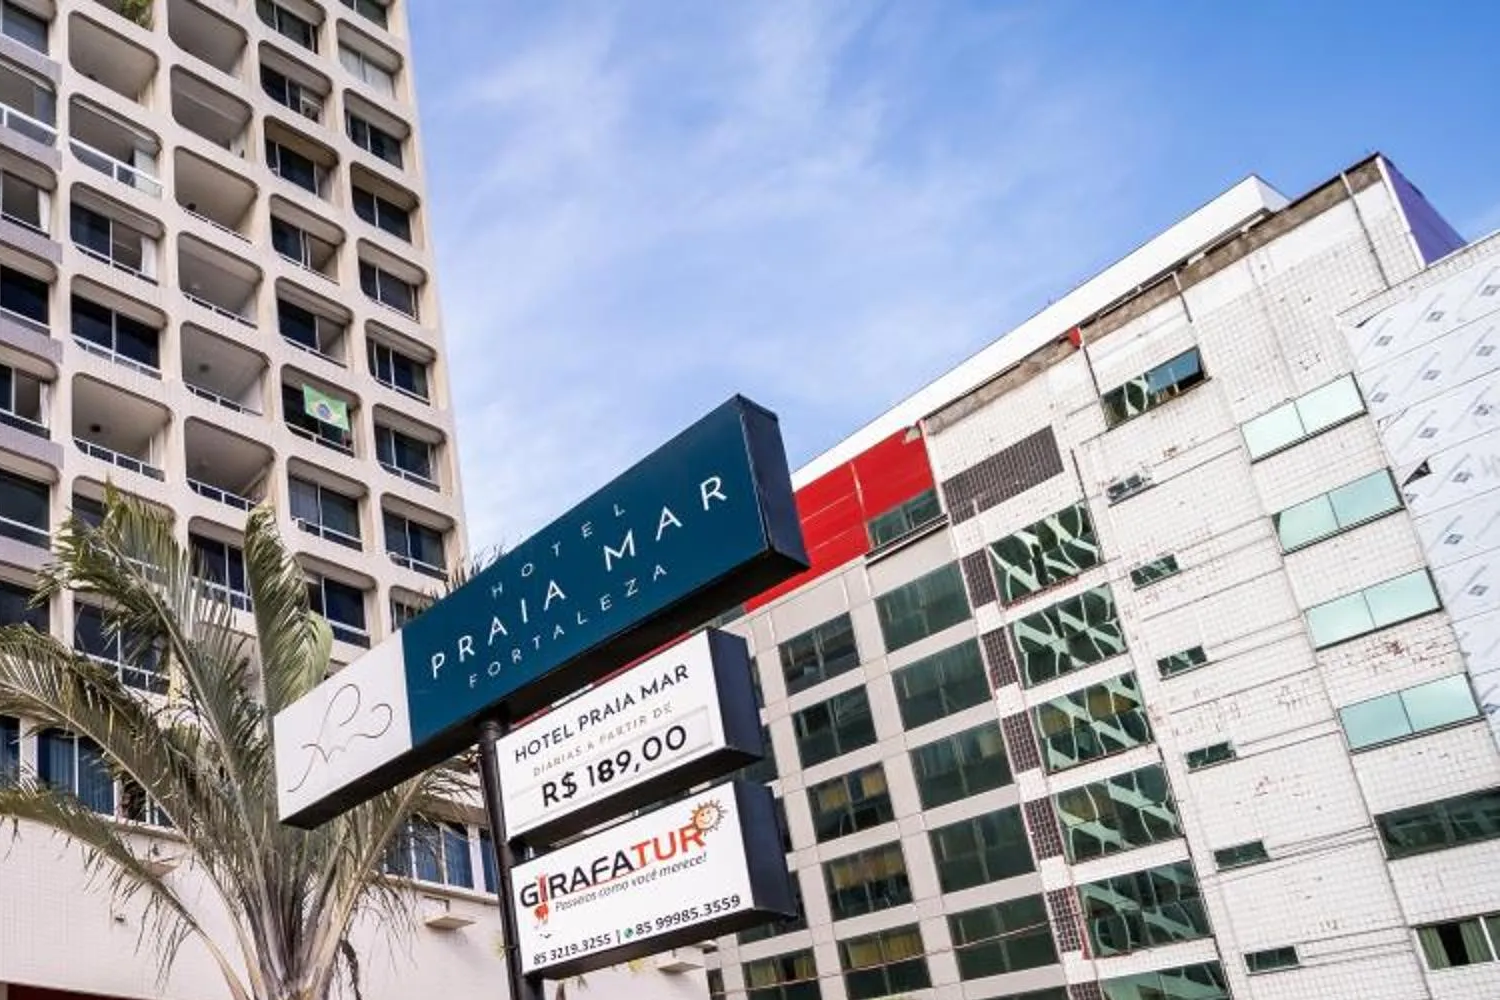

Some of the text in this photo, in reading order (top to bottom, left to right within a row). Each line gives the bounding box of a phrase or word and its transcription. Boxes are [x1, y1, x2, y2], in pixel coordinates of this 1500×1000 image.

[431, 475, 728, 679] PRAIA MAR
[492, 503, 626, 597] HOTEL
[469, 564, 668, 688] FORTALEZA
[514, 663, 689, 764] HOTEL PRAIA MAR
[599, 715, 647, 742] PARTIR
[653, 701, 674, 719] DE
[542, 725, 687, 808] R$ 189,00
[520, 822, 706, 909] GIRAFATUR
[599, 881, 629, 897] como
[631, 871, 658, 888] você
[659, 852, 708, 877] merece!
[533, 952, 547, 966] 85
[550, 933, 611, 963] 3219.3255
[635, 921, 653, 936] 85
[655, 895, 741, 931] 99985.3559
